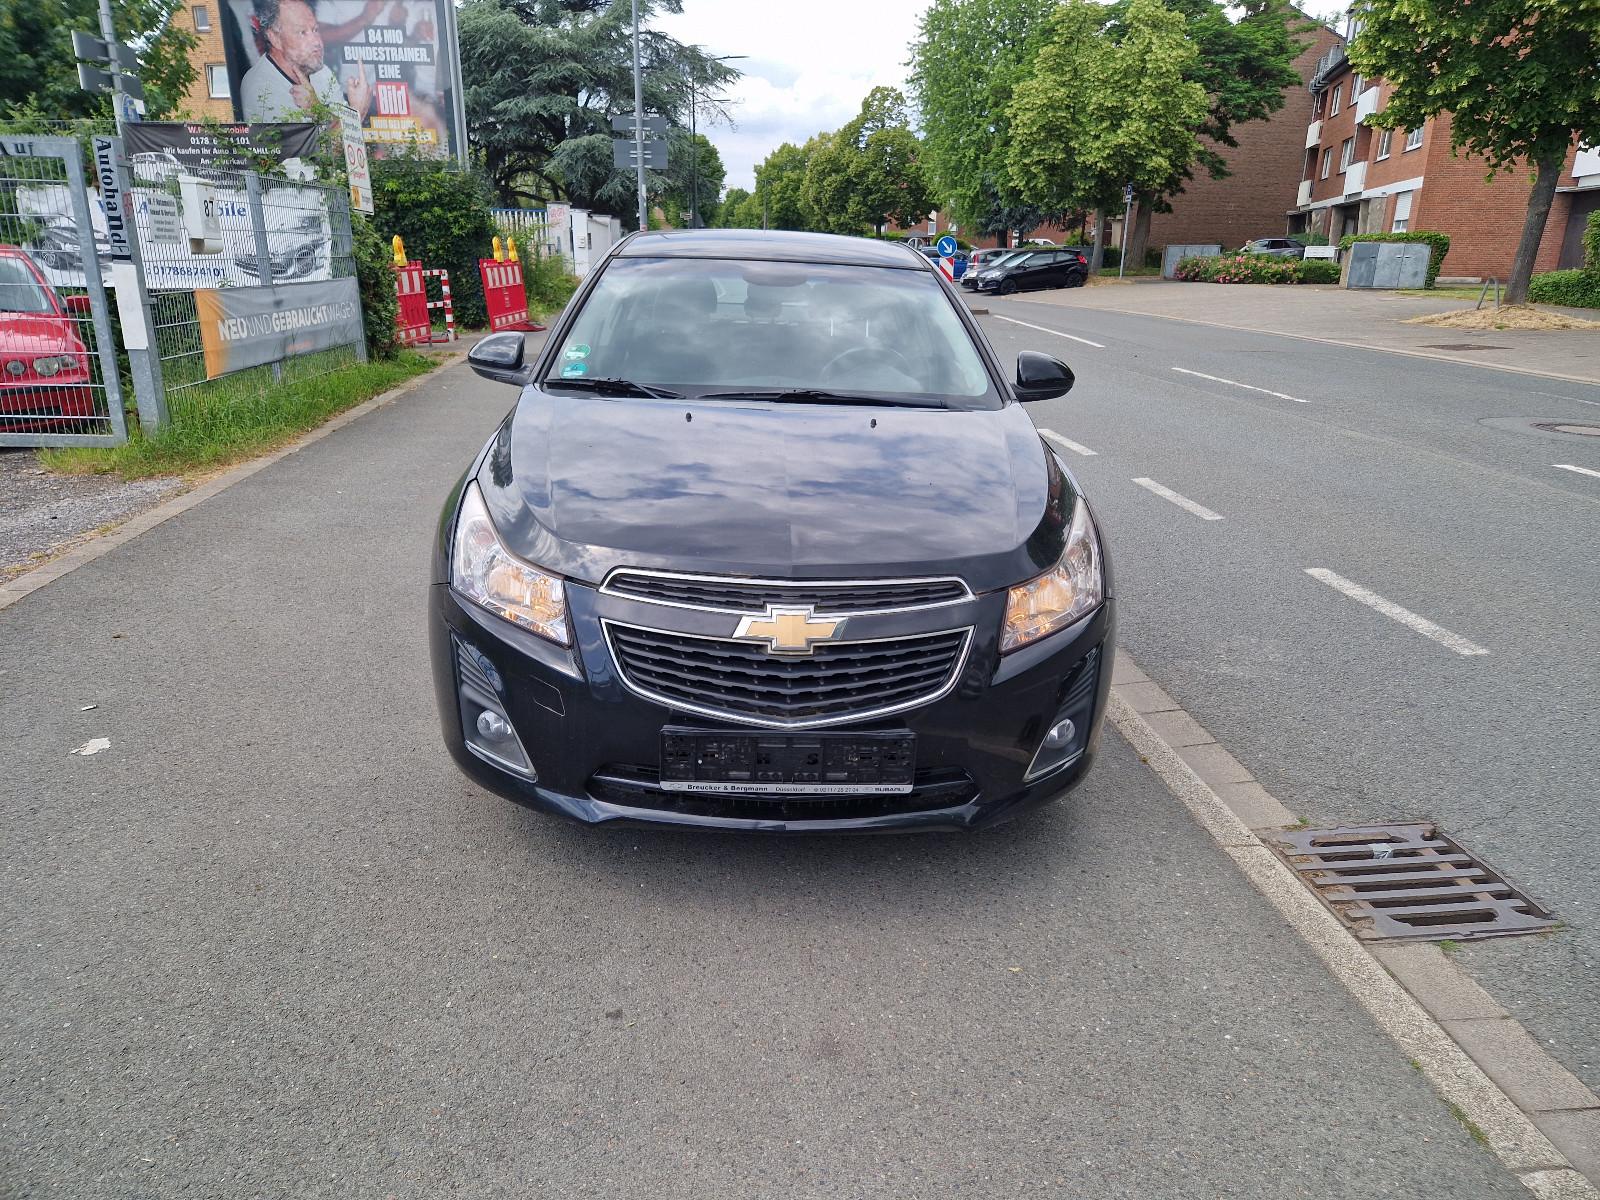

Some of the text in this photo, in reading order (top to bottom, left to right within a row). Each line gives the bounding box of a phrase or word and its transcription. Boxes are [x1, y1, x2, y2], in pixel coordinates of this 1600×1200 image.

[367, 29, 404, 44] 84 MIO
[343, 46, 431, 62] BUNDESTRAINER.
[378, 64, 402, 79] EINE
[190, 137, 209, 146] 0178
[163, 147, 176, 155] Wir
[176, 147, 201, 155] kaufen
[201, 147, 212, 155] Ihr
[212, 147, 229, 155] Auto
[204, 199, 214, 218] 87
